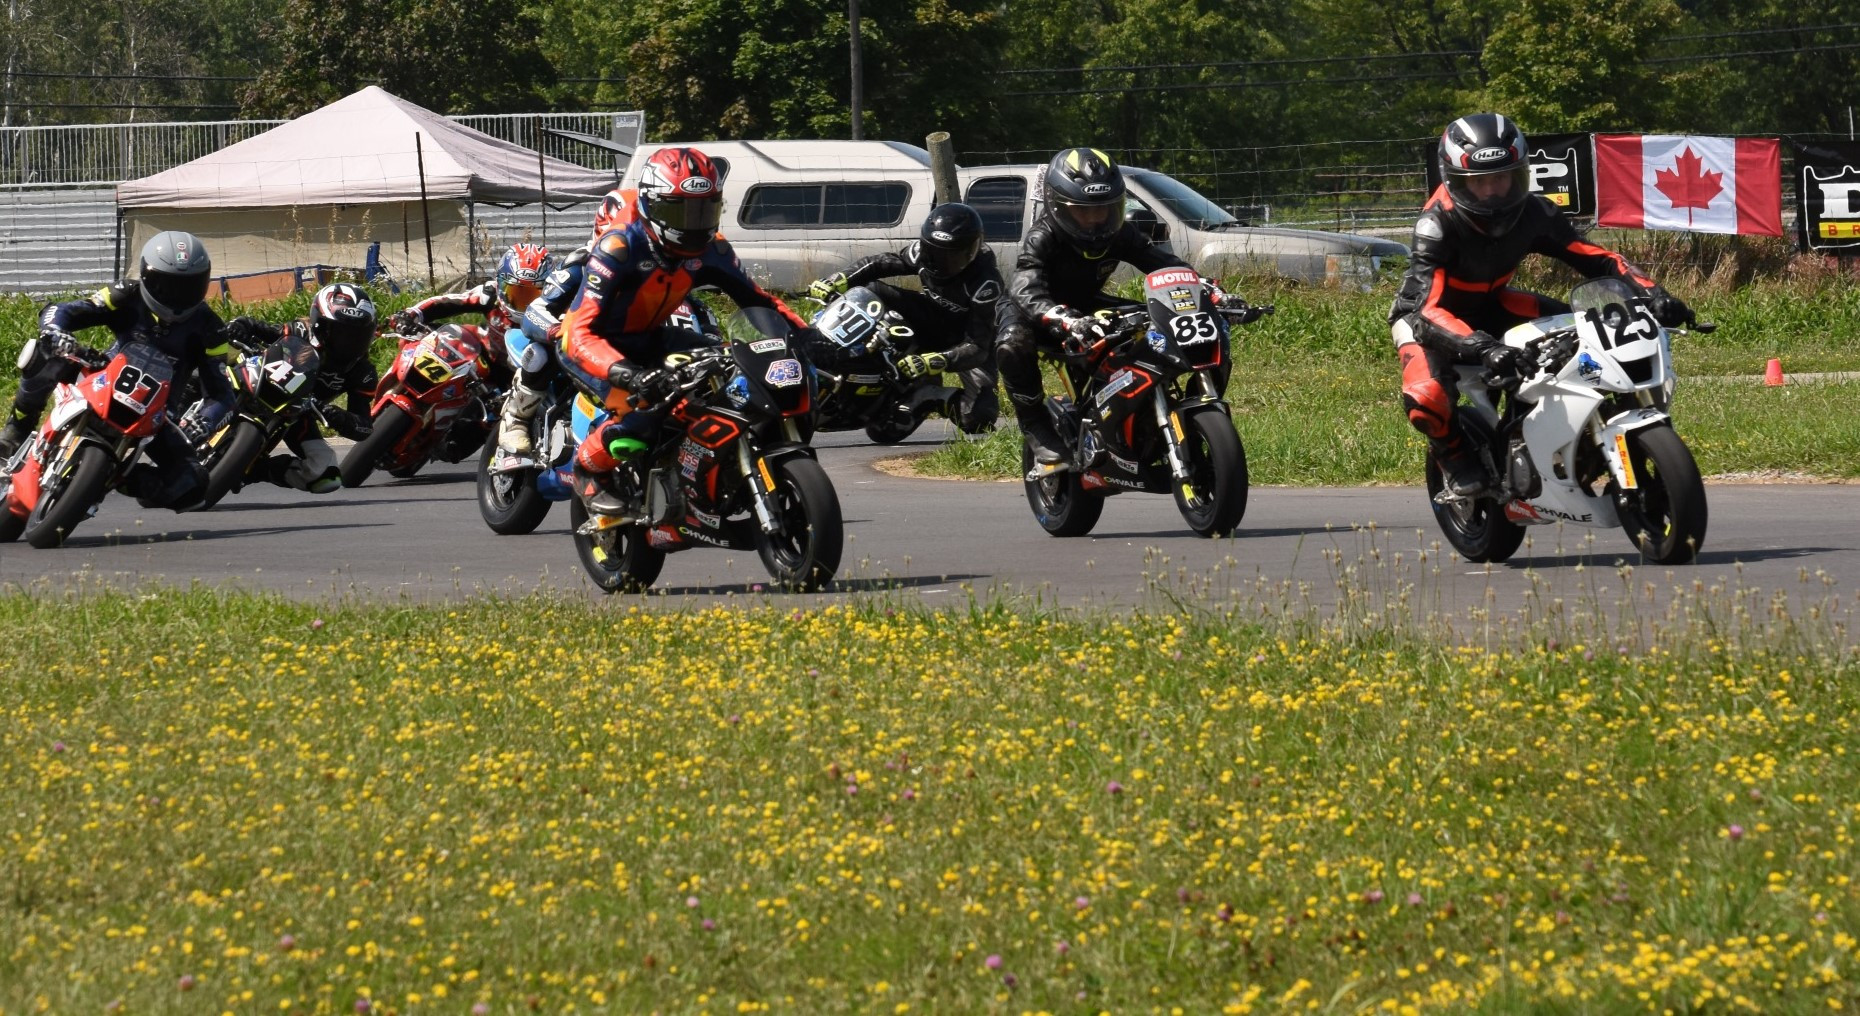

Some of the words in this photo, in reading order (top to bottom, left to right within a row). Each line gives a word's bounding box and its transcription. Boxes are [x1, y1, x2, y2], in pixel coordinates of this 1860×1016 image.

[1478, 149, 1505, 159] HJC
[688, 180, 709, 189] Arai
[1151, 272, 1196, 287] MOTUL
[1174, 314, 1215, 343] 83
[1583, 298, 1659, 352] 125
[263, 360, 307, 395] 41
[415, 355, 449, 381] 14
[768, 361, 800, 382] 43
[114, 365, 162, 409] 87
[1103, 476, 1145, 489] OHVALE
[1532, 505, 1593, 522] OHVALE
[679, 526, 730, 548] OHVALE
